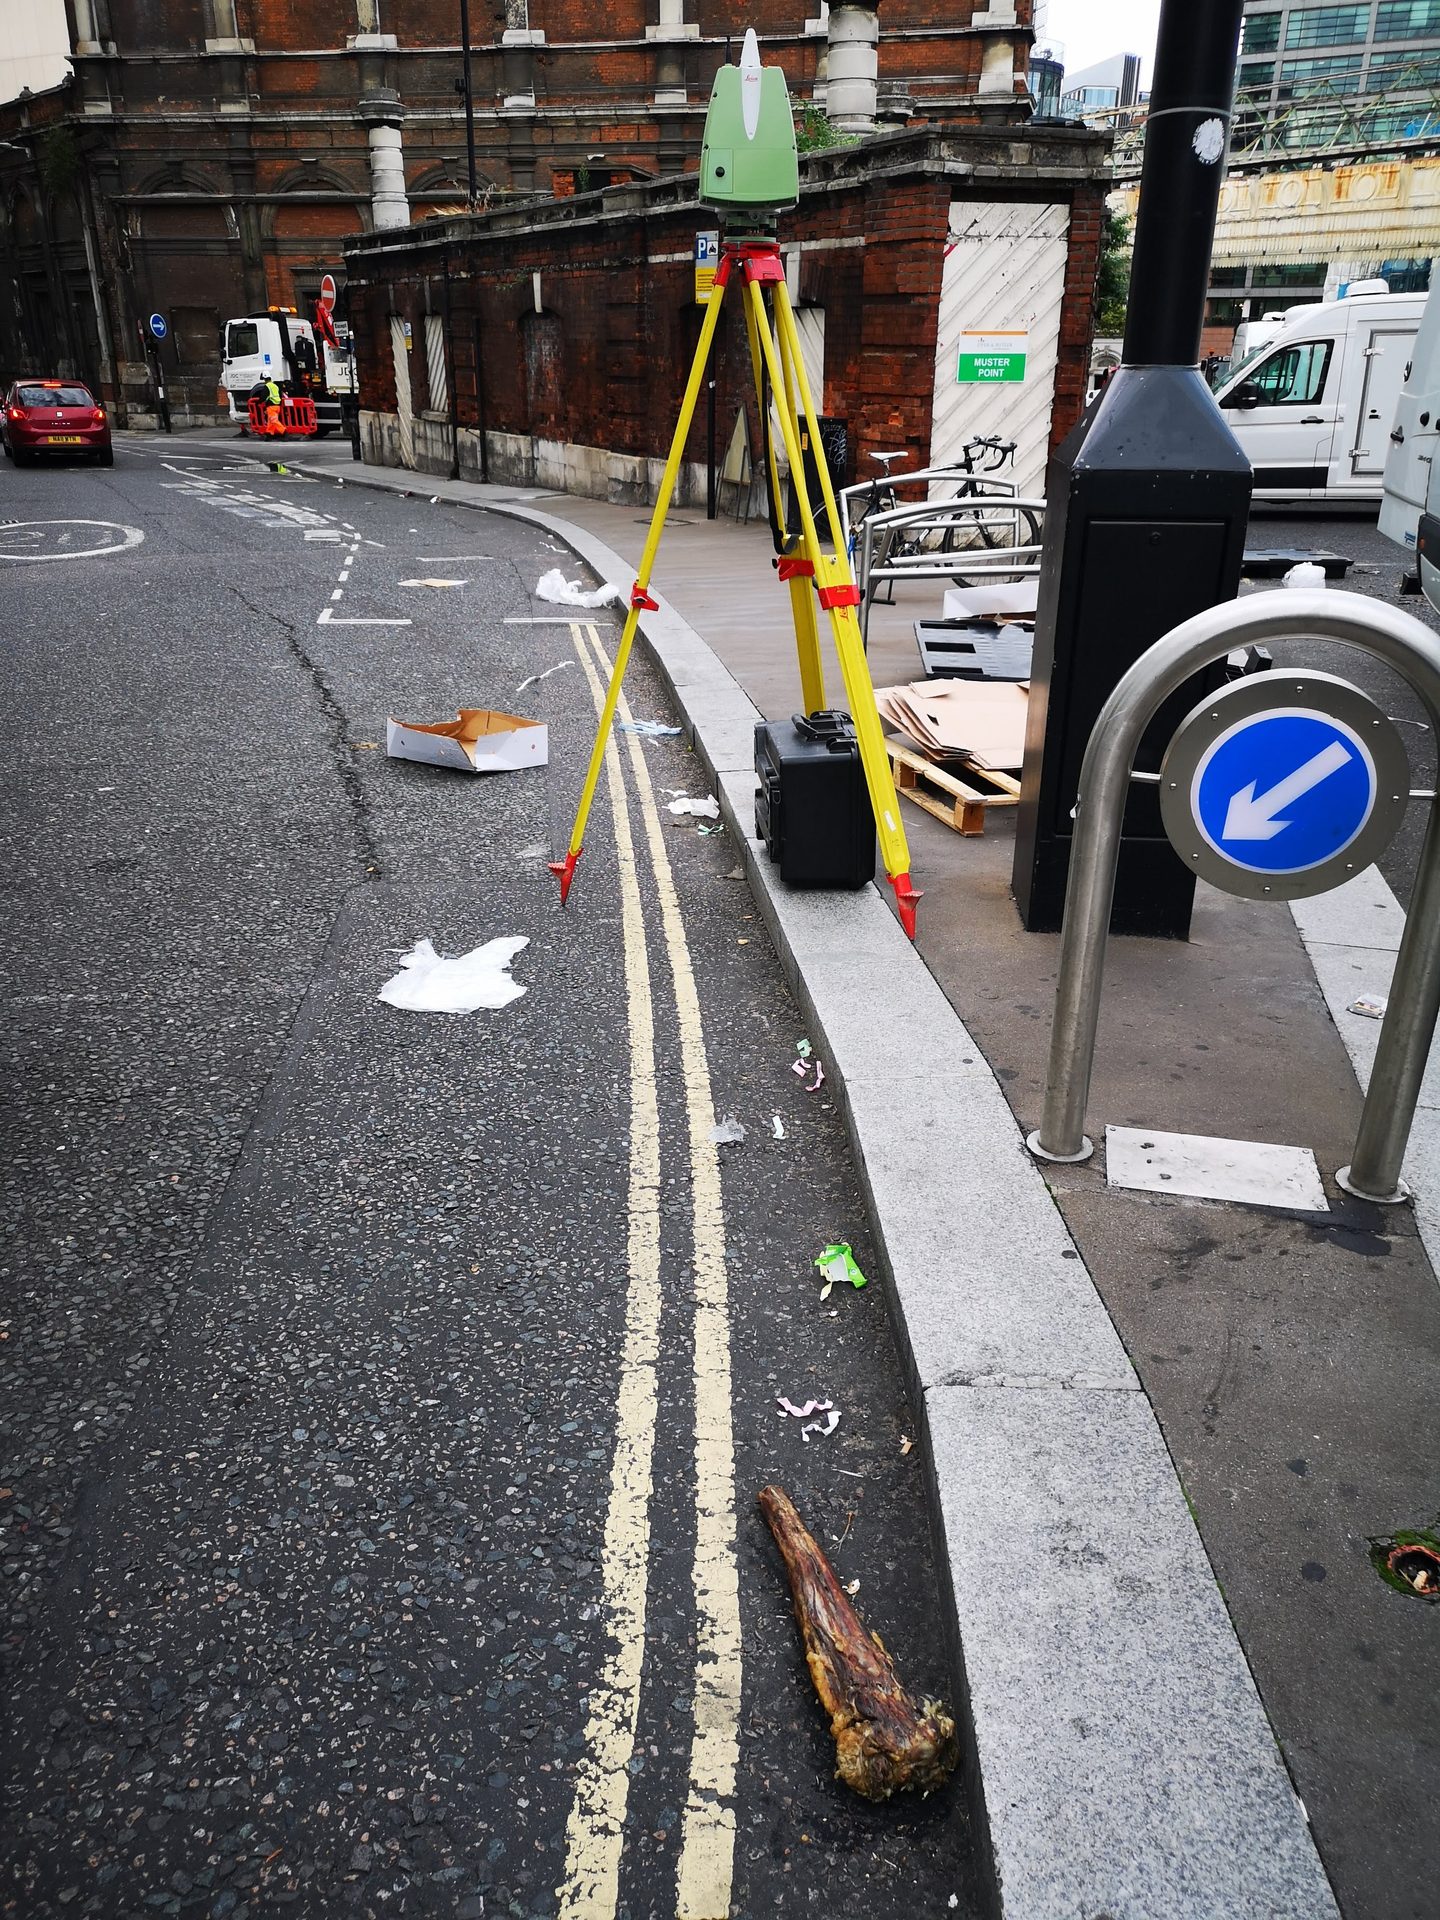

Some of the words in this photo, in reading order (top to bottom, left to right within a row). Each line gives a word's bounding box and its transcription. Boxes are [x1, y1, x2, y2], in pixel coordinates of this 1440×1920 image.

[698, 239, 706, 258] P
[974, 358, 1010, 367] MUSTER
[978, 368, 1005, 377] POINT
